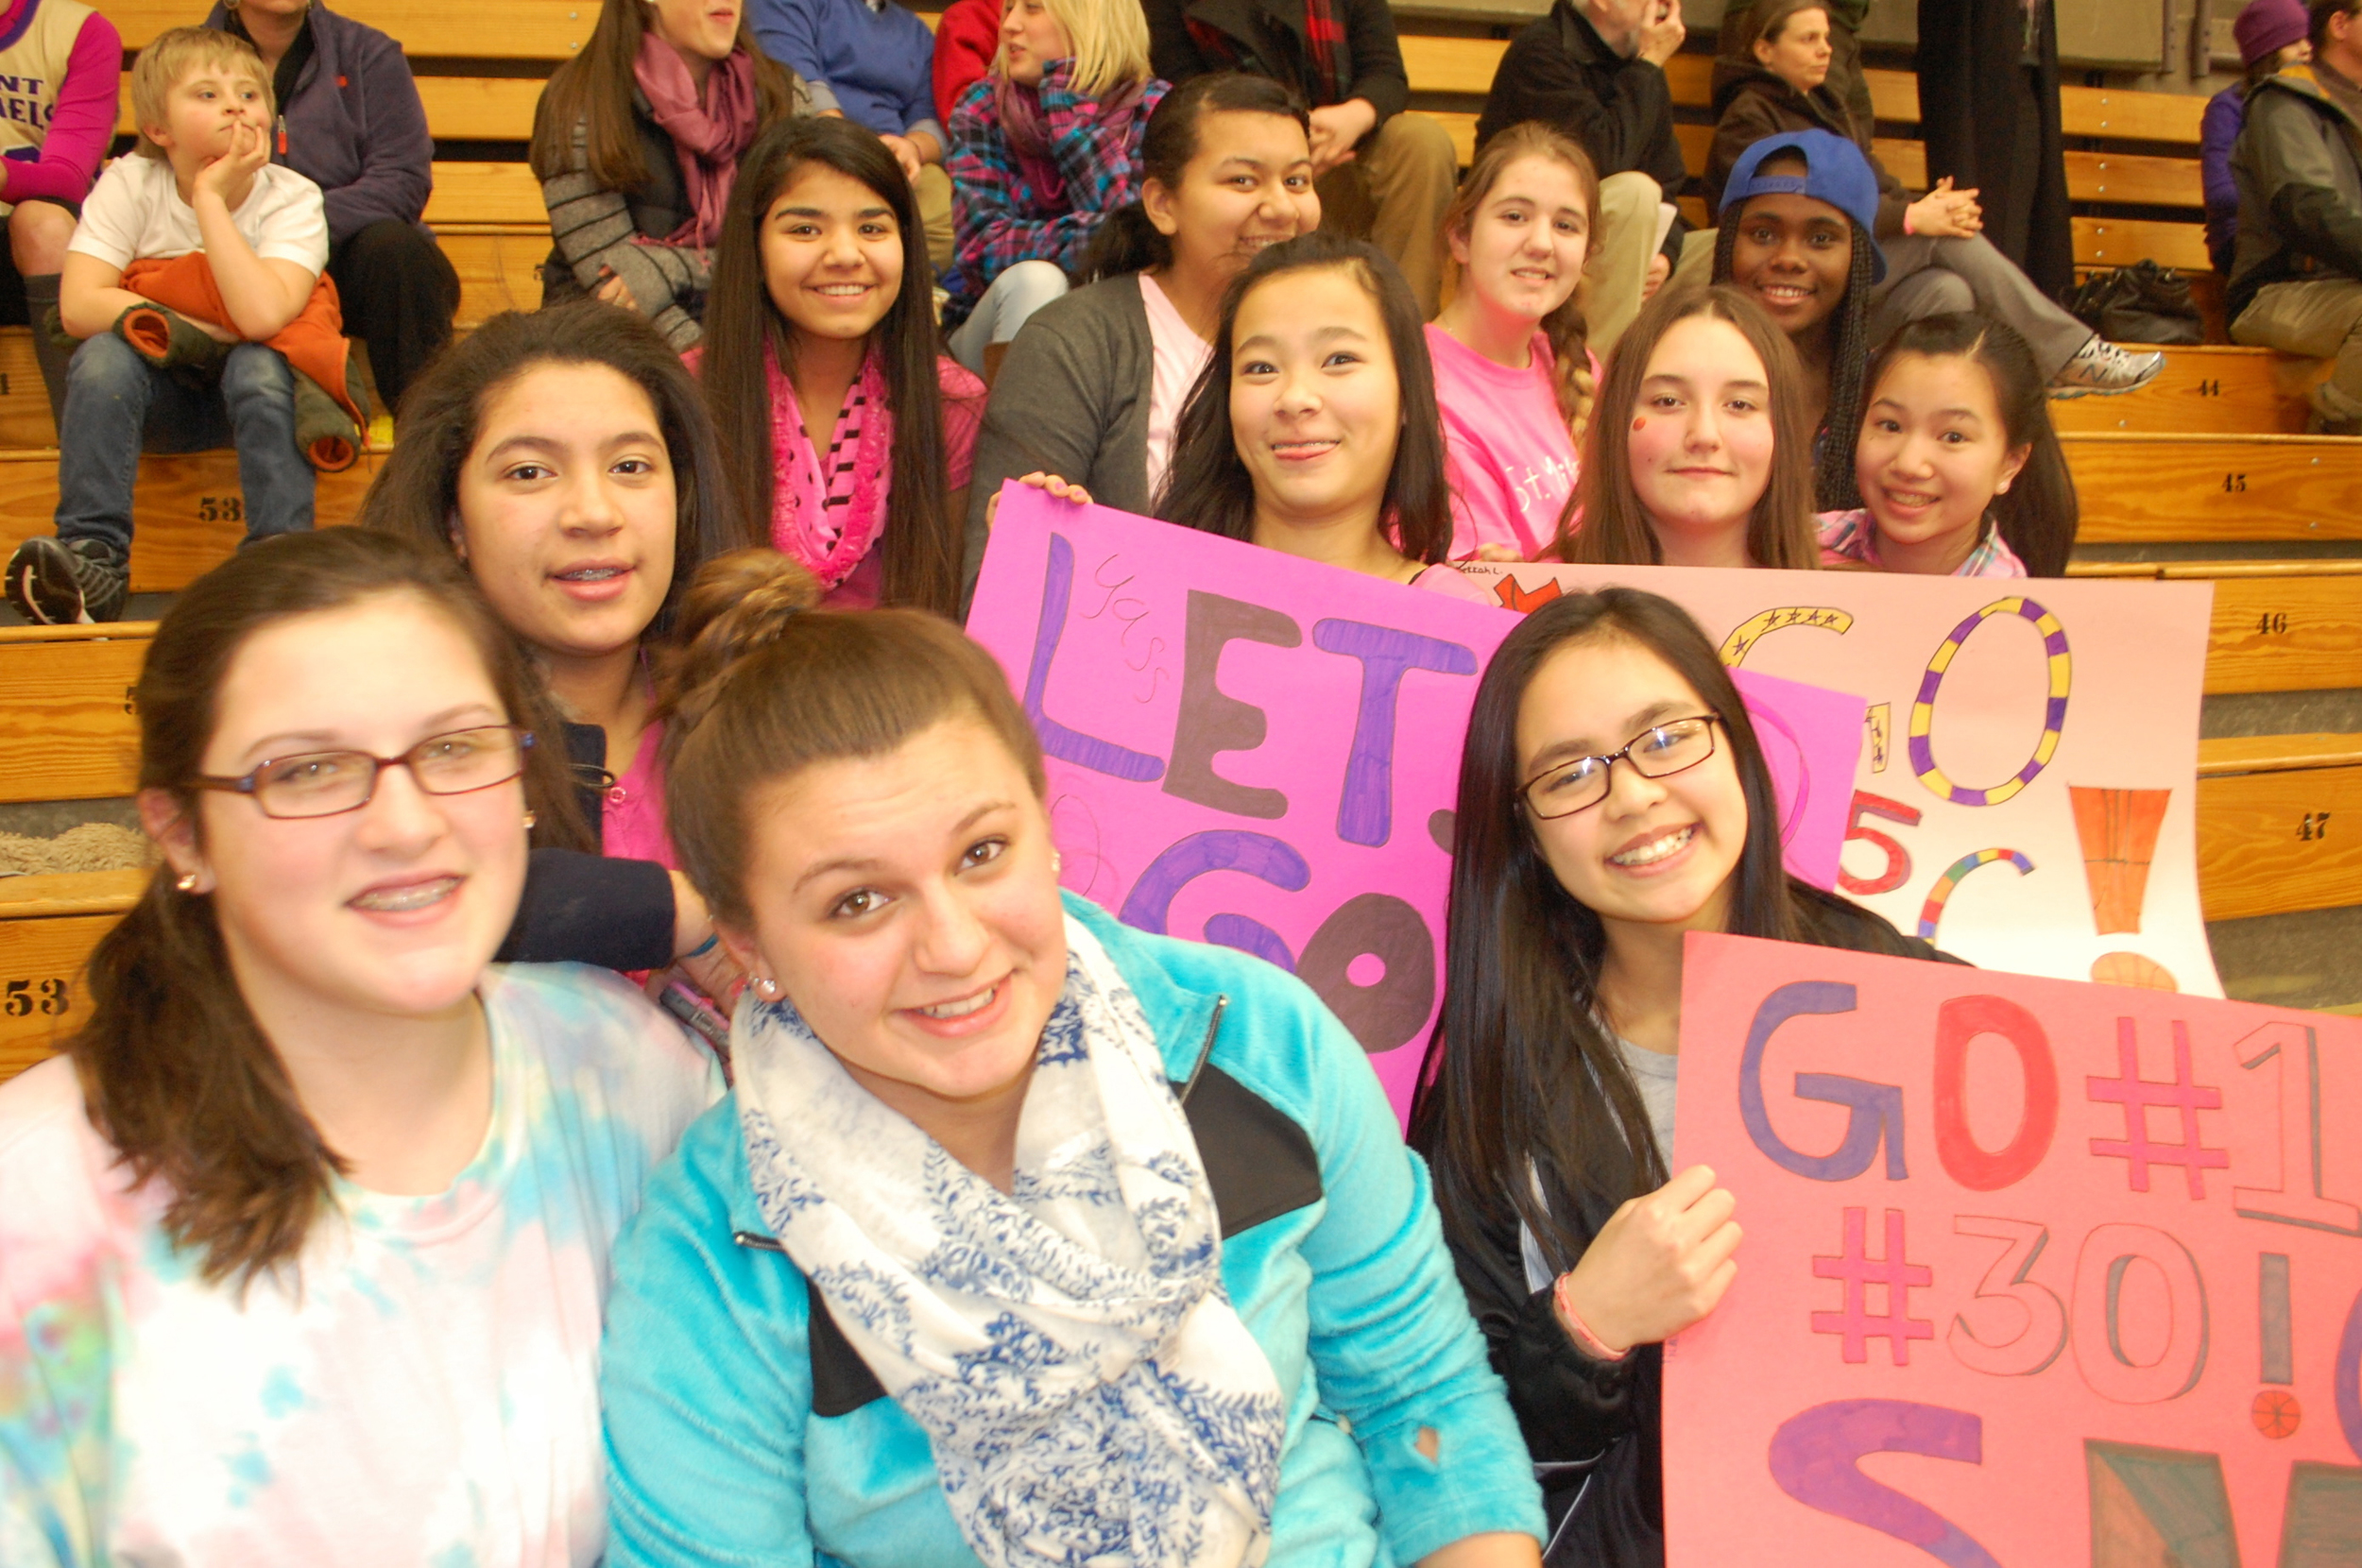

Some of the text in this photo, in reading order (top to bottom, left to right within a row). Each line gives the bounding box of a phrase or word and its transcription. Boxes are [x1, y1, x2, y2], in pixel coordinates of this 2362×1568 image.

[2221, 473, 2247, 492] 45
[199, 497, 241, 521] 53
[2256, 611, 2288, 636] 46
[2296, 811, 2332, 842] 47
[5, 978, 70, 1017] 53
[1737, 980, 2061, 1193] GO
